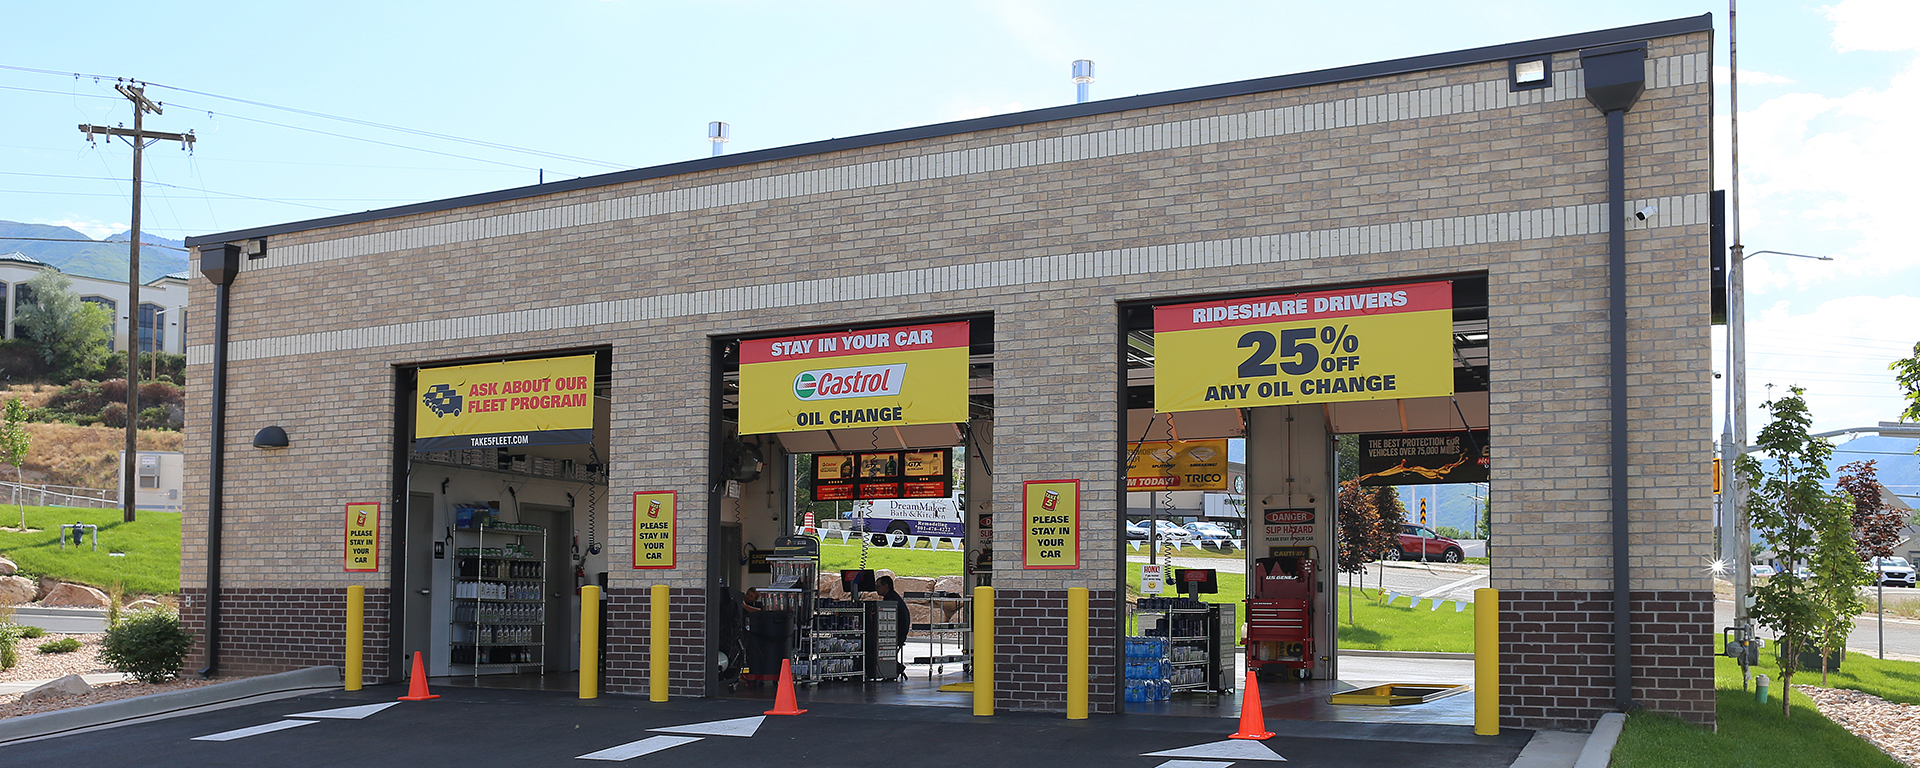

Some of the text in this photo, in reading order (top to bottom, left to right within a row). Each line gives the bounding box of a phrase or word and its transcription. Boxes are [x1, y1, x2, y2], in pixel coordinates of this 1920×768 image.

[1193, 290, 1408, 323] RIDESHARE DRIVERS
[771, 330, 933, 357] STAY IN YOUR CAR
[1320, 356, 1360, 373] OFF
[469, 376, 587, 396] ASK ABOUT OUR
[817, 368, 891, 396] Castrol
[1204, 374, 1396, 401] ANY OIL CHANGE
[468, 394, 586, 413] FLEET PROGRAM
[796, 407, 902, 426] OIL CHANGE
[471, 435, 528, 446] TAKE5FLEET.COM
[1369, 440, 1382, 448] THE
[1384, 439, 1400, 448] BEST
[1402, 437, 1445, 447] PROTECTION
[1369, 446, 1460, 457] VEHICLES OVER 75,000 MES
[1185, 474, 1221, 483] TRICO
[890, 500, 946, 512] DreamMaker
